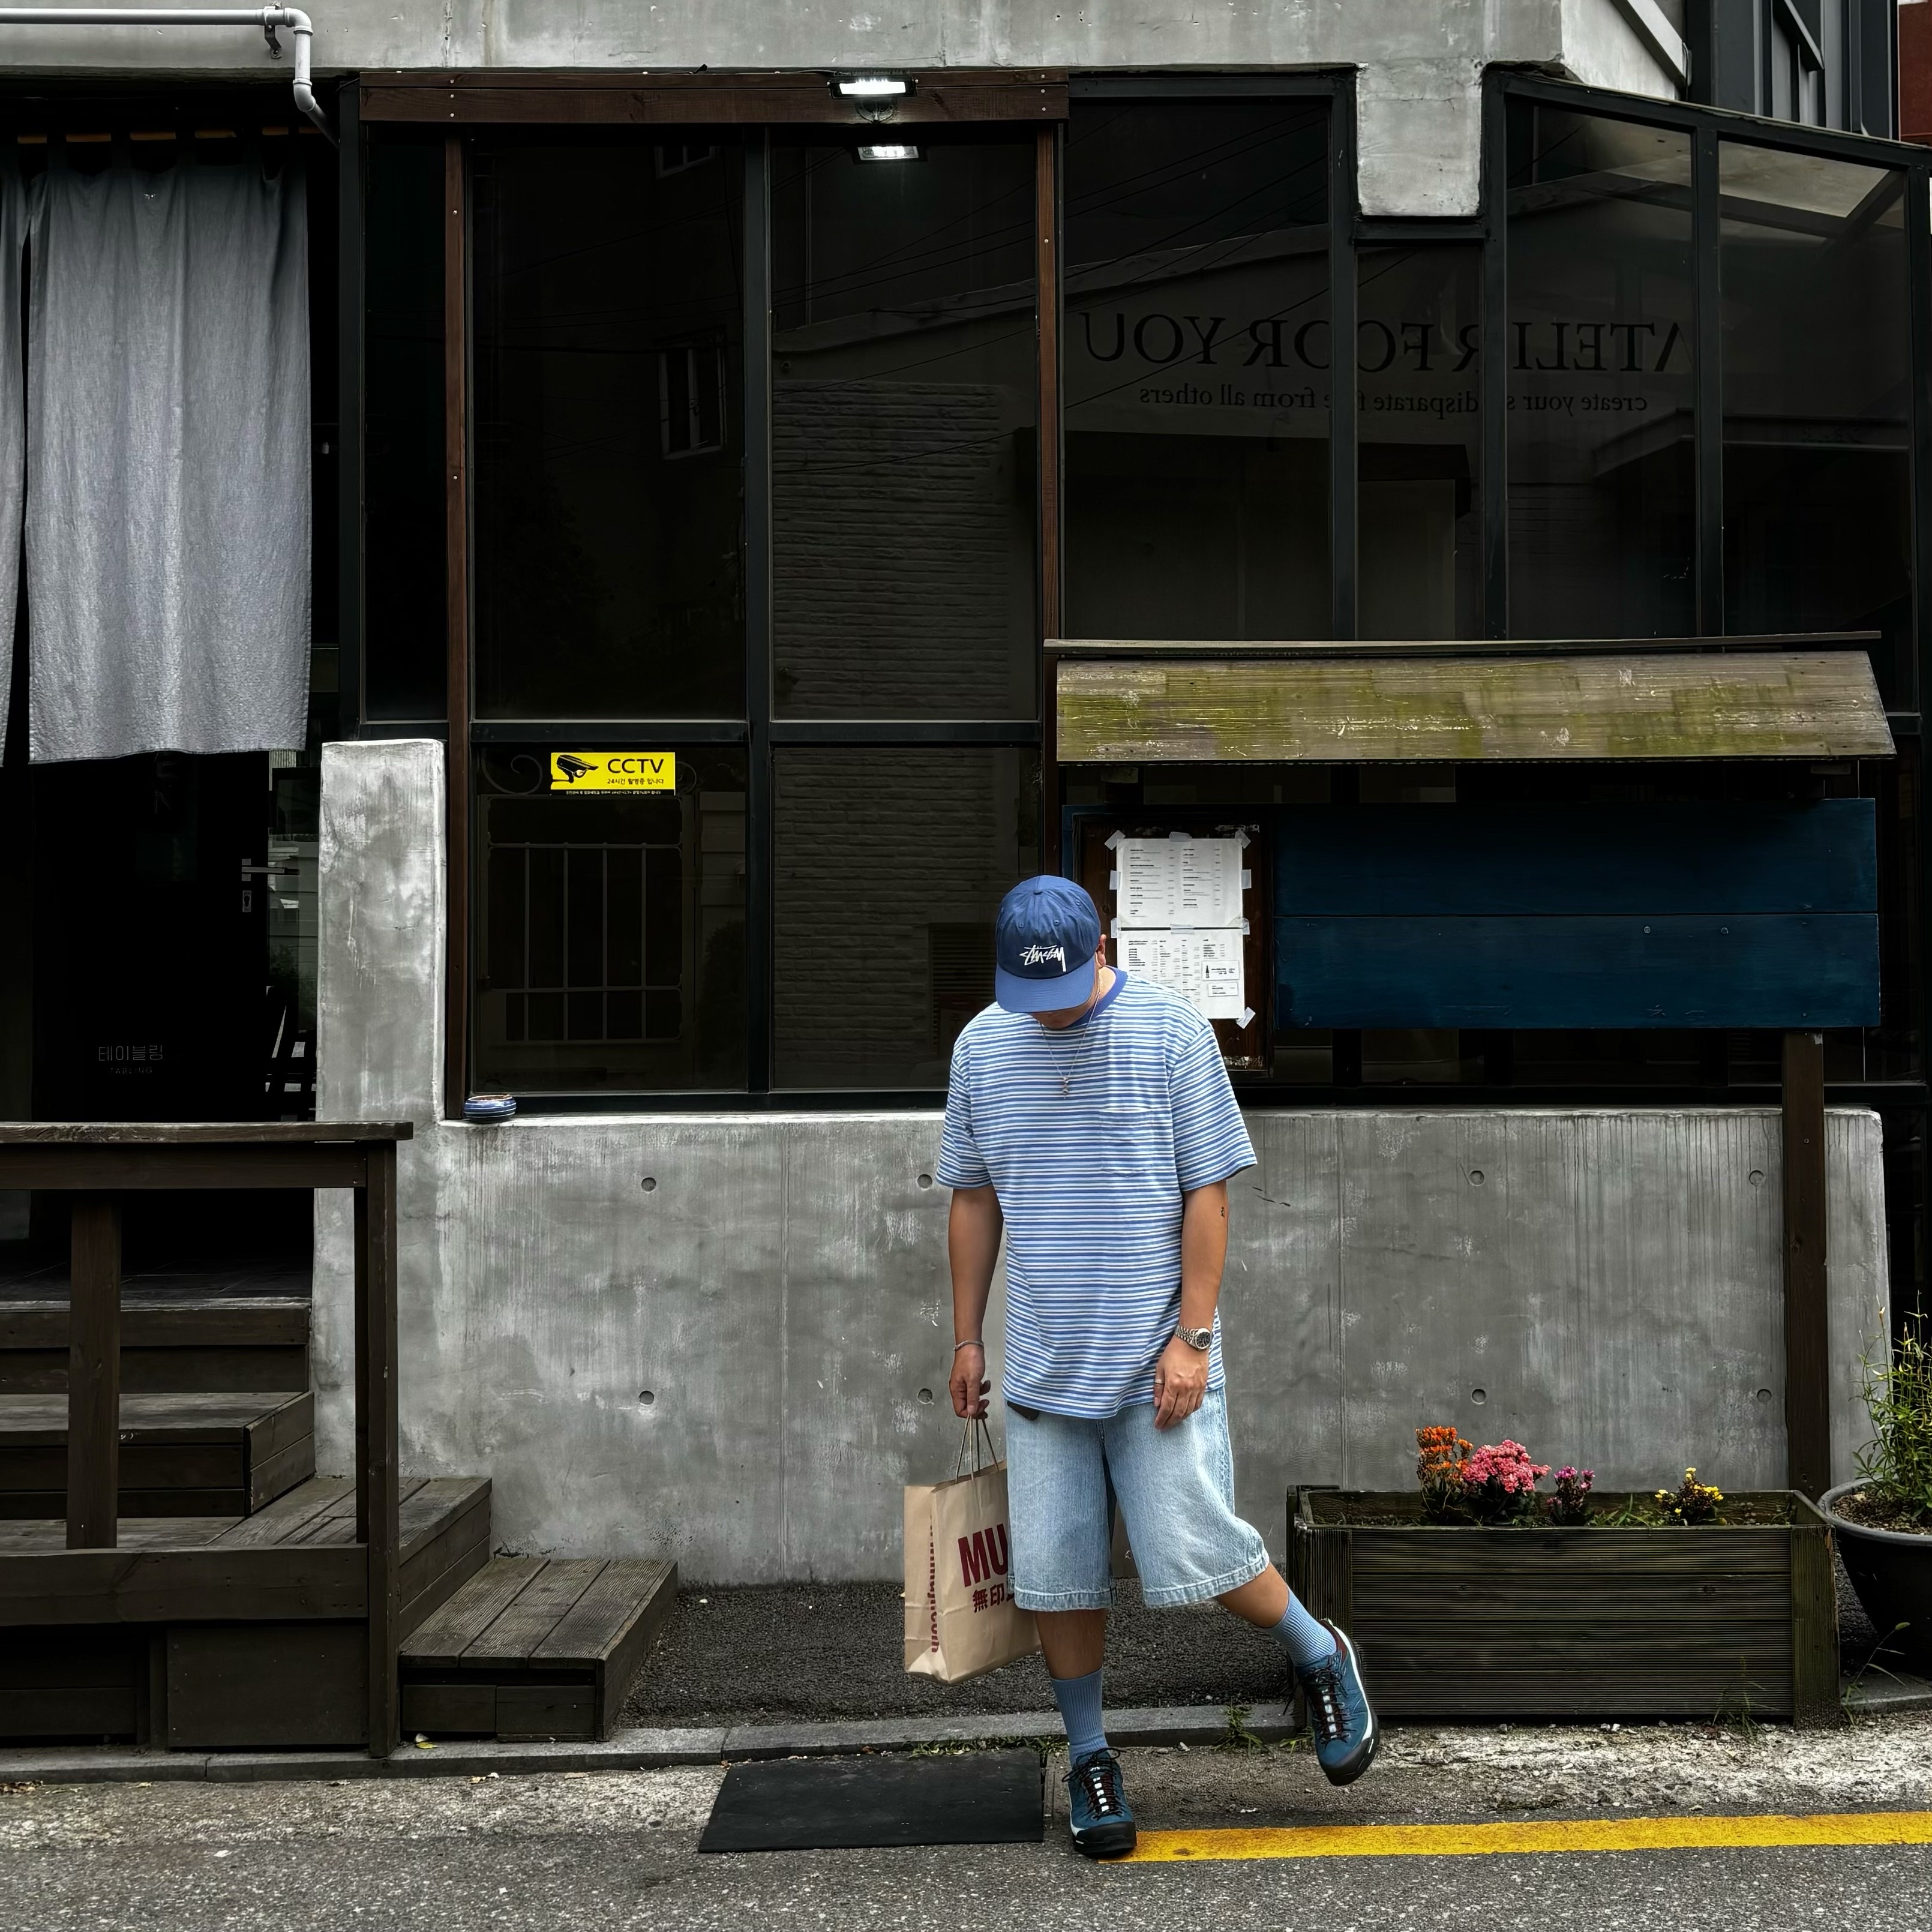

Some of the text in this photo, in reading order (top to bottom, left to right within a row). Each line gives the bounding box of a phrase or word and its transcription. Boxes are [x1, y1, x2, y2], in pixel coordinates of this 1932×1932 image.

[607, 758, 664, 774] CCTV
[98, 1044, 163, 1061] 테이블링
[973, 1583, 1015, 1613] 無印
